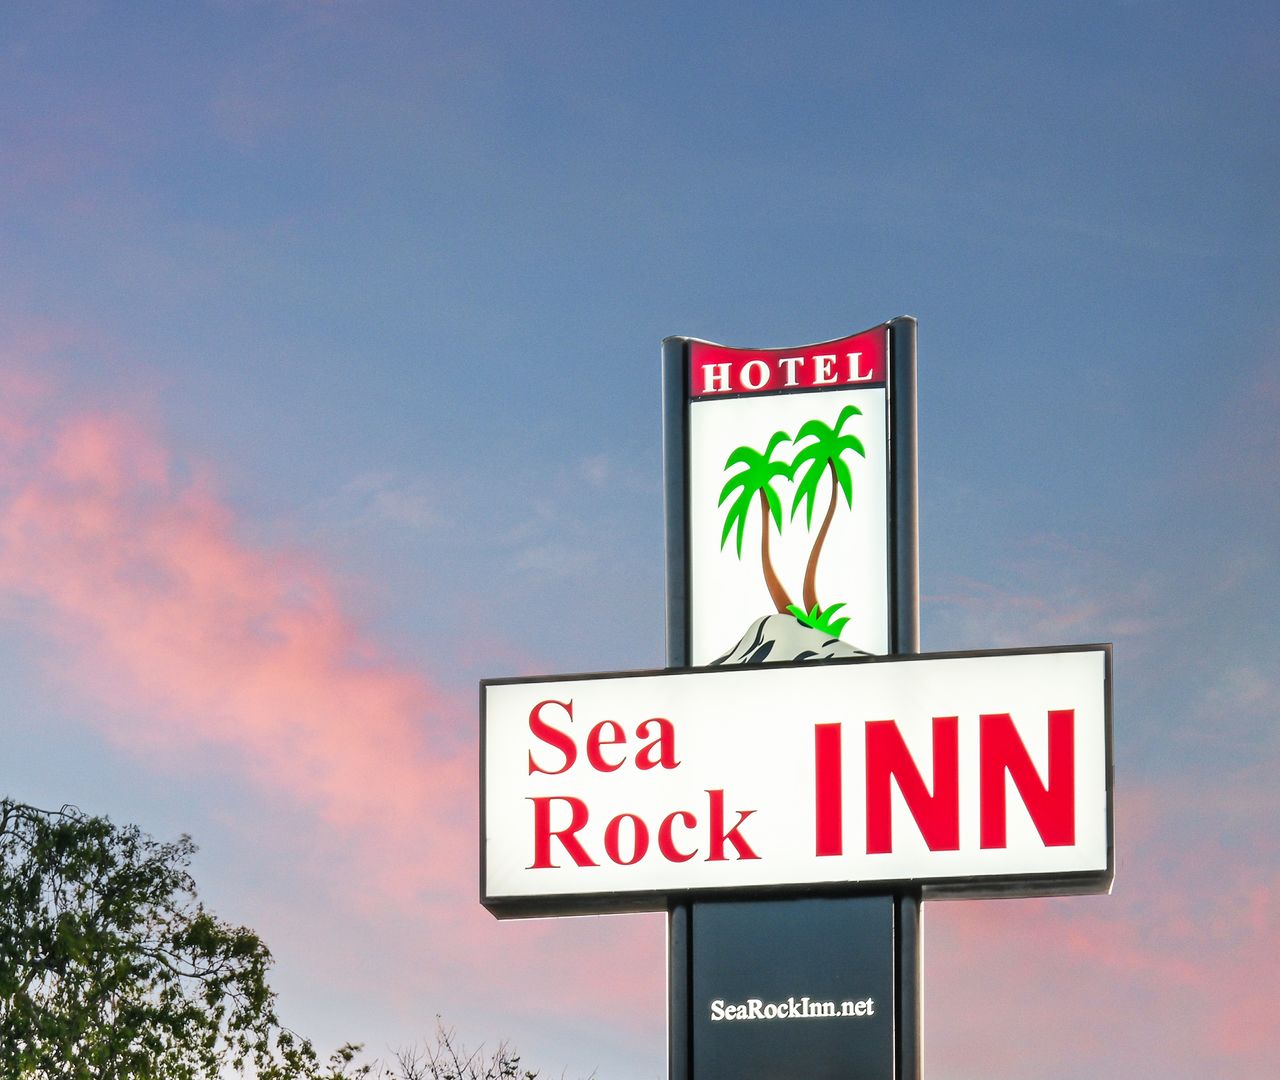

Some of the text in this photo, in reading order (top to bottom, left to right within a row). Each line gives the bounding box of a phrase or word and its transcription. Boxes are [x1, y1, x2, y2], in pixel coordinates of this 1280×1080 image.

[701, 352, 873, 393] HOTEL
[527, 699, 681, 777] Sea
[814, 709, 1076, 857] INN
[525, 789, 762, 869] Rock
[710, 997, 875, 1021] SeaRockInn.net
